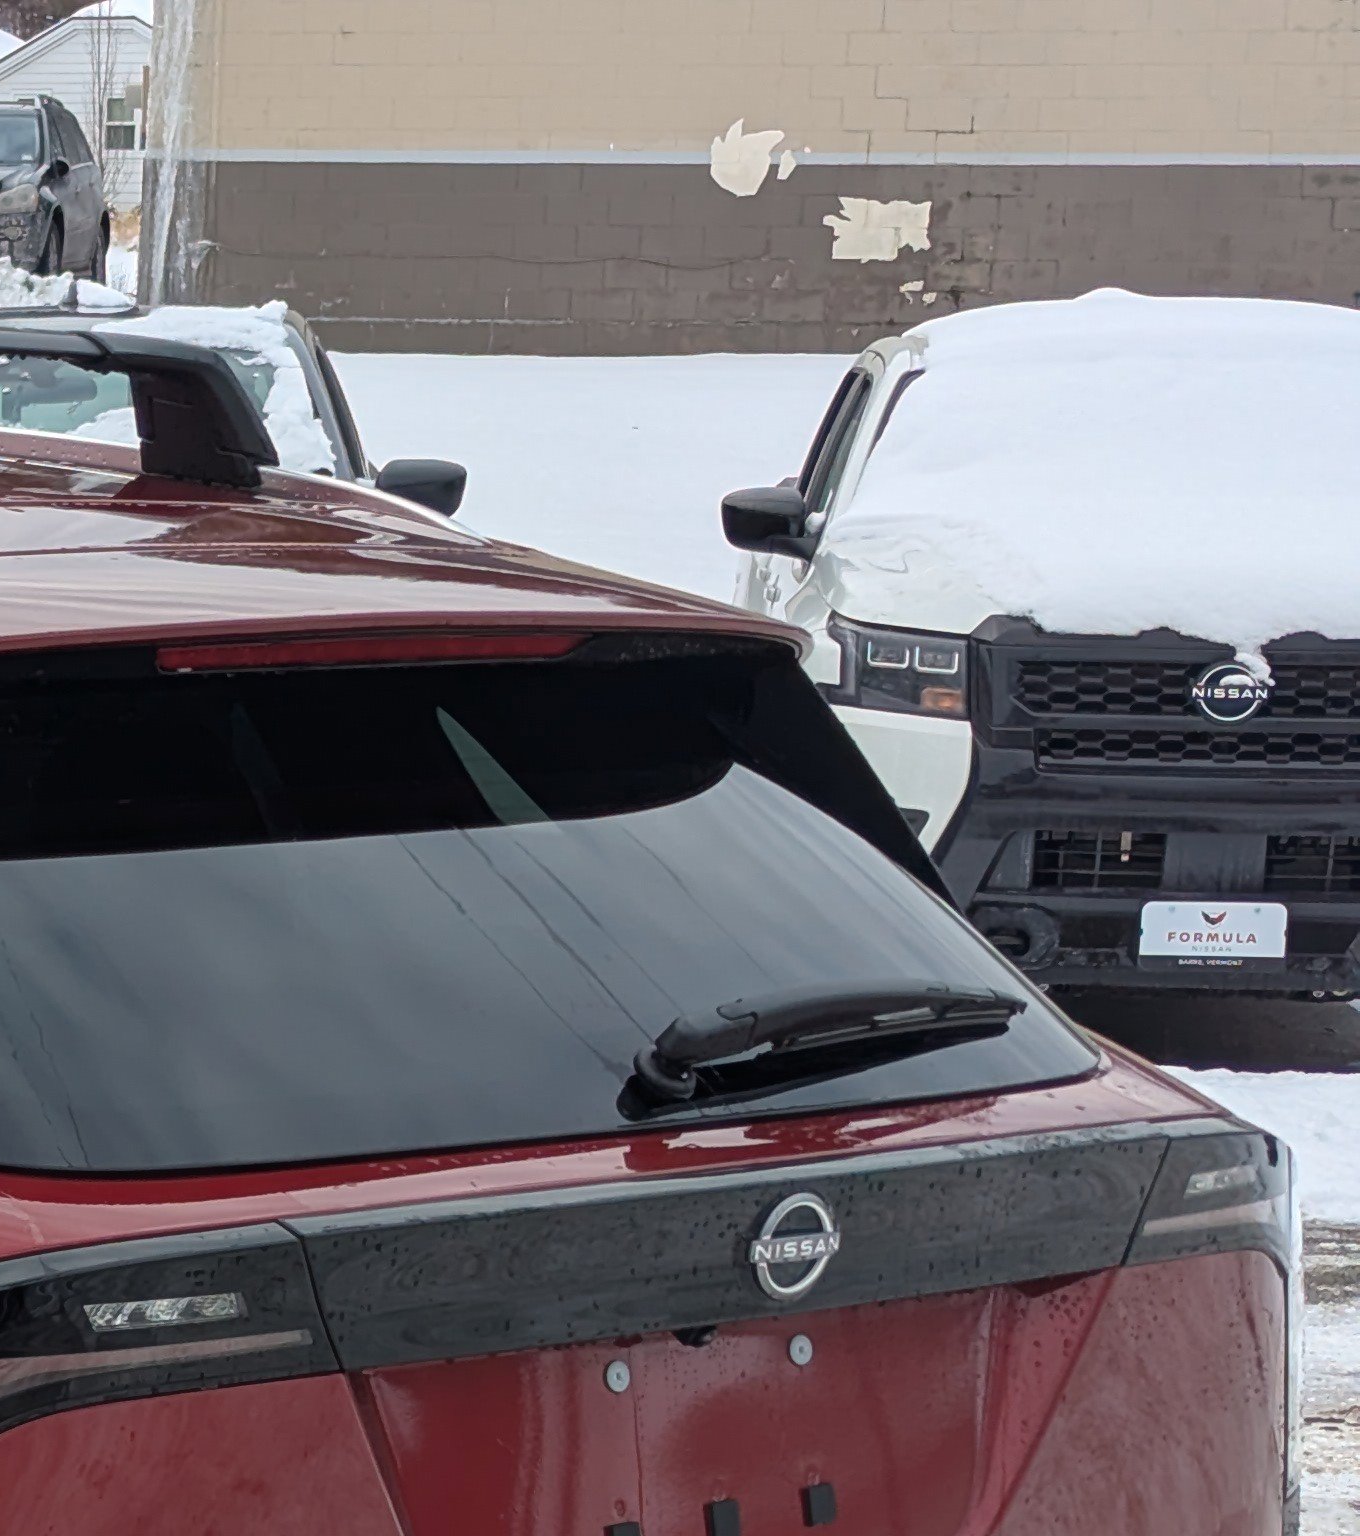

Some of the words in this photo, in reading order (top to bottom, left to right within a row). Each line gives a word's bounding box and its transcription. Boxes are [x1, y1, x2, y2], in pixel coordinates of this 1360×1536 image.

[1191, 686, 1268, 699] NISSAN
[1166, 931, 1258, 944] FORMULA
[754, 1235, 840, 1261] NISSAN
